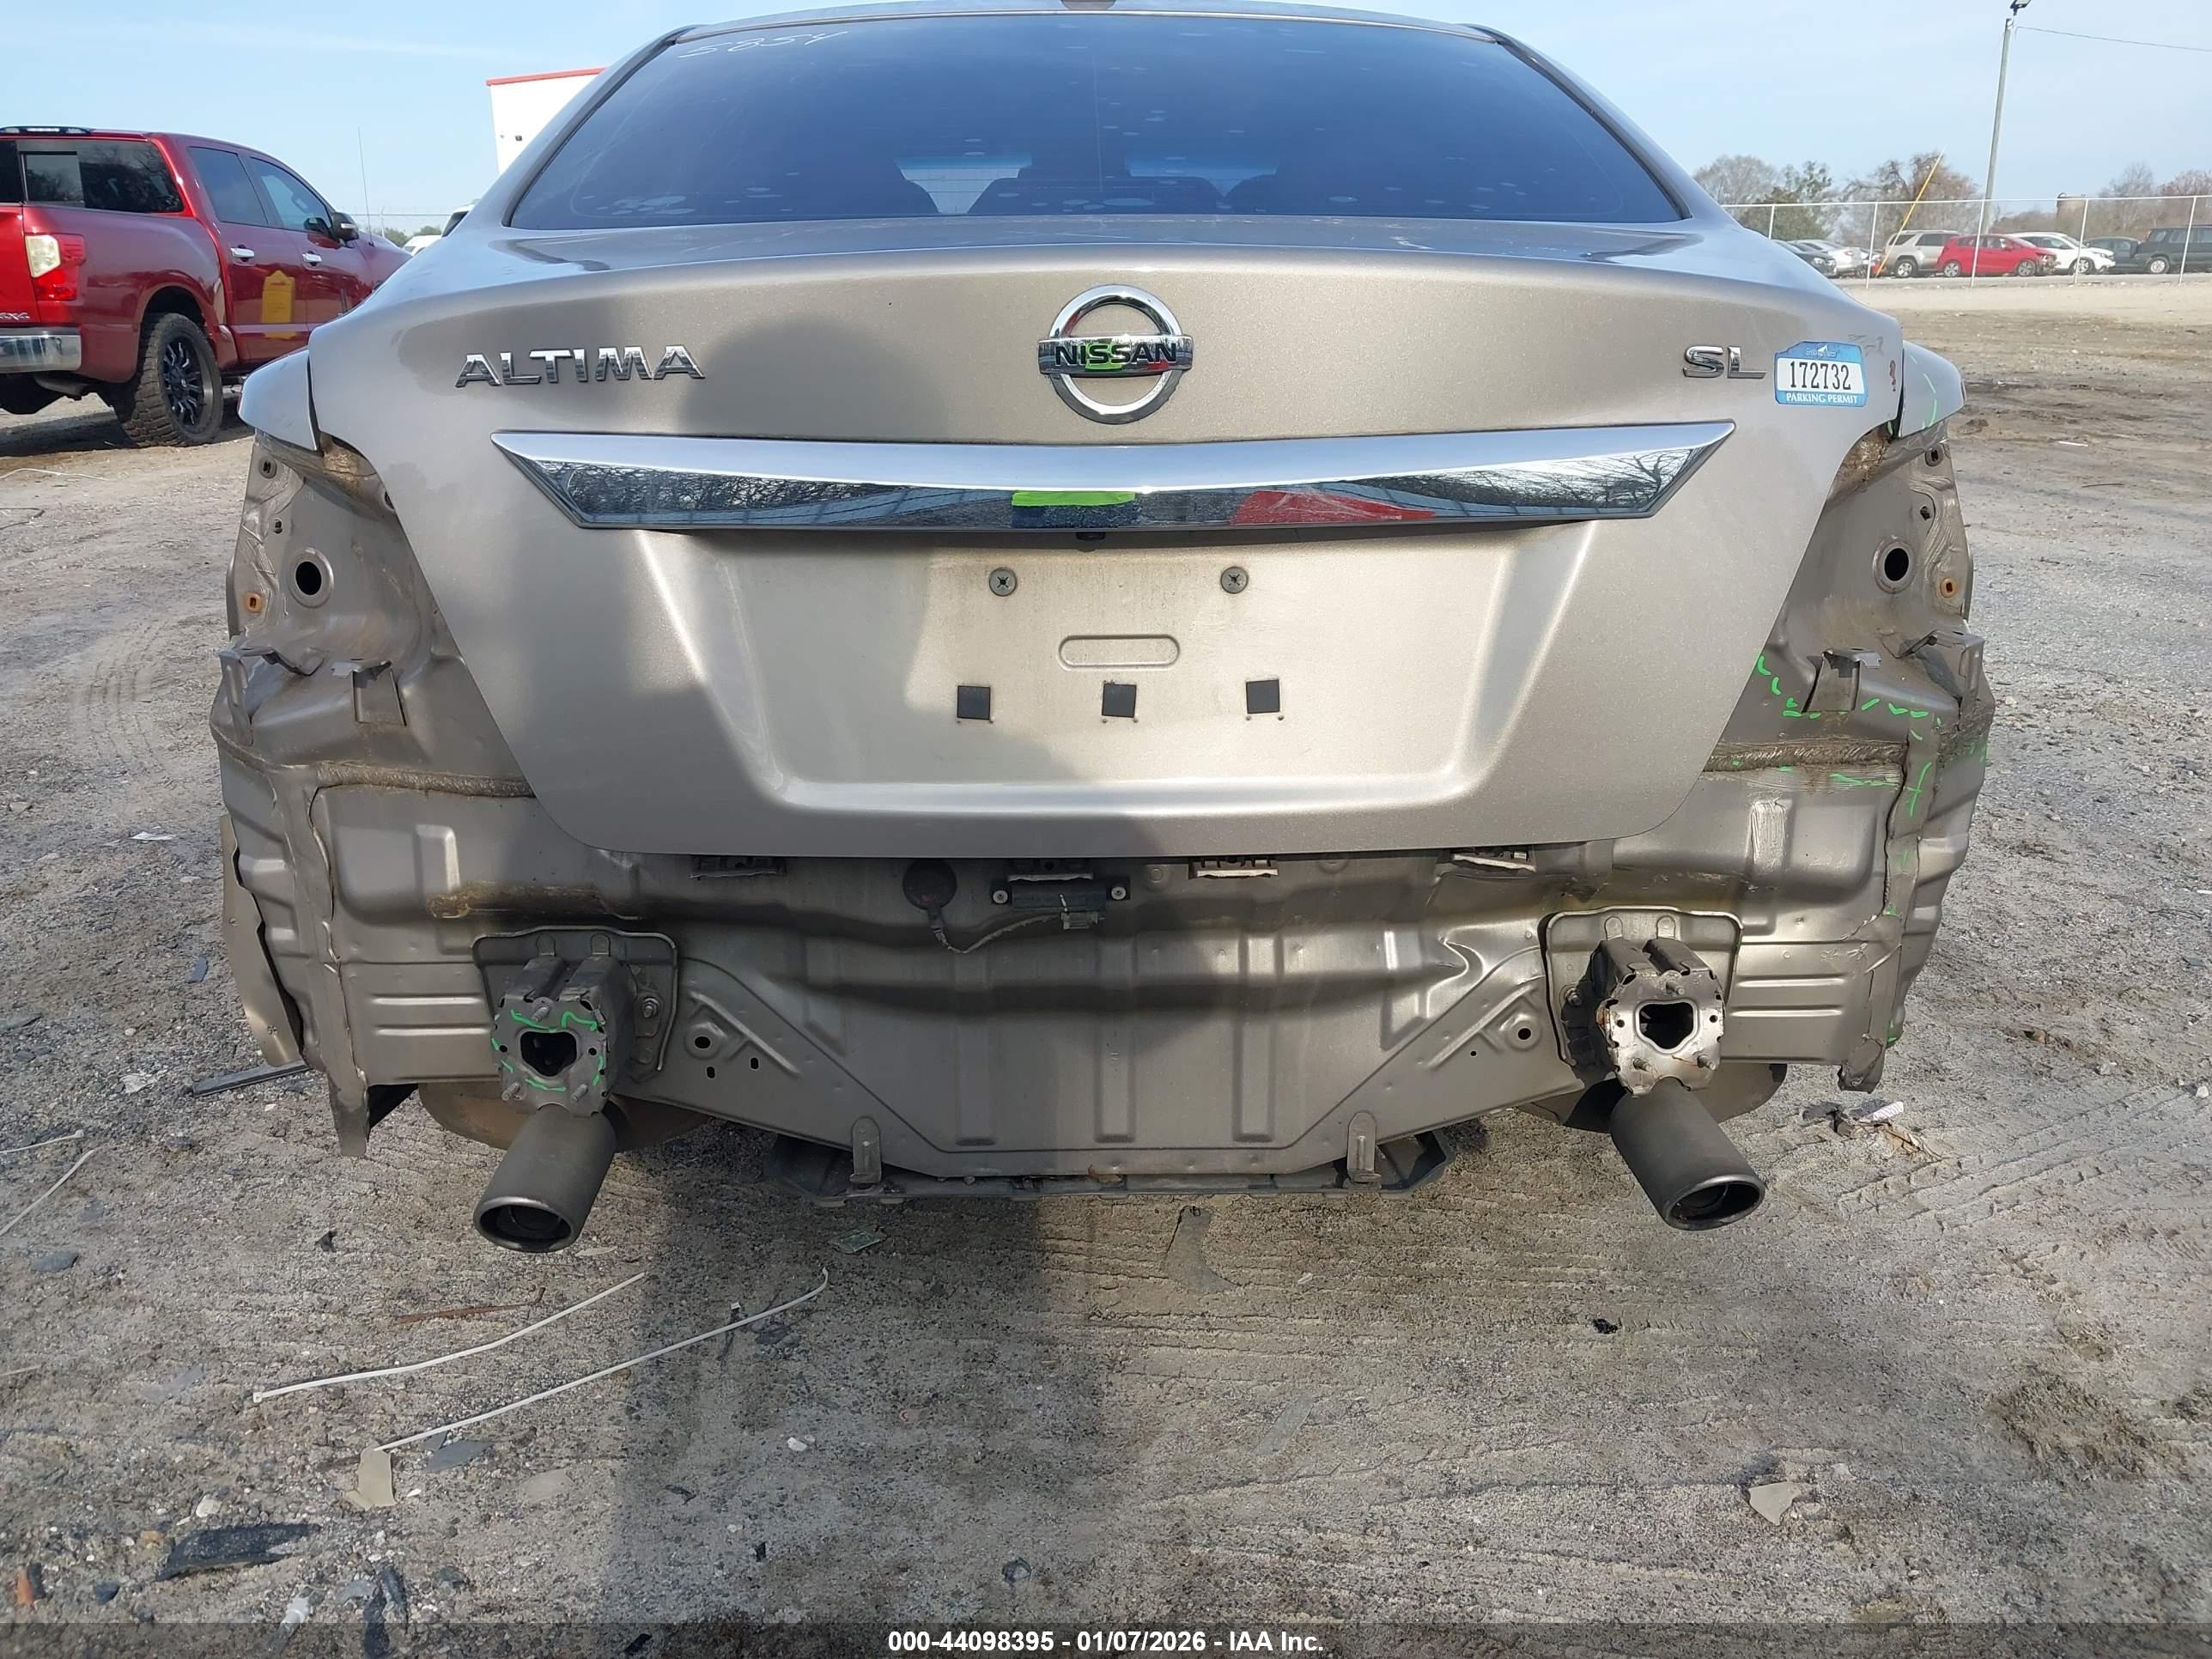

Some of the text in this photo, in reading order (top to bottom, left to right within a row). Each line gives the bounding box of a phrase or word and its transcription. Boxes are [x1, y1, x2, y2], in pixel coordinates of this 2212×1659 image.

[455, 344, 706, 387] ALTIMA
[1054, 343, 1176, 366] NISSAN
[1683, 345, 1767, 379] SL
[1790, 361, 1851, 391] 172732
[1786, 392, 1858, 404] PARKING PERMIT
